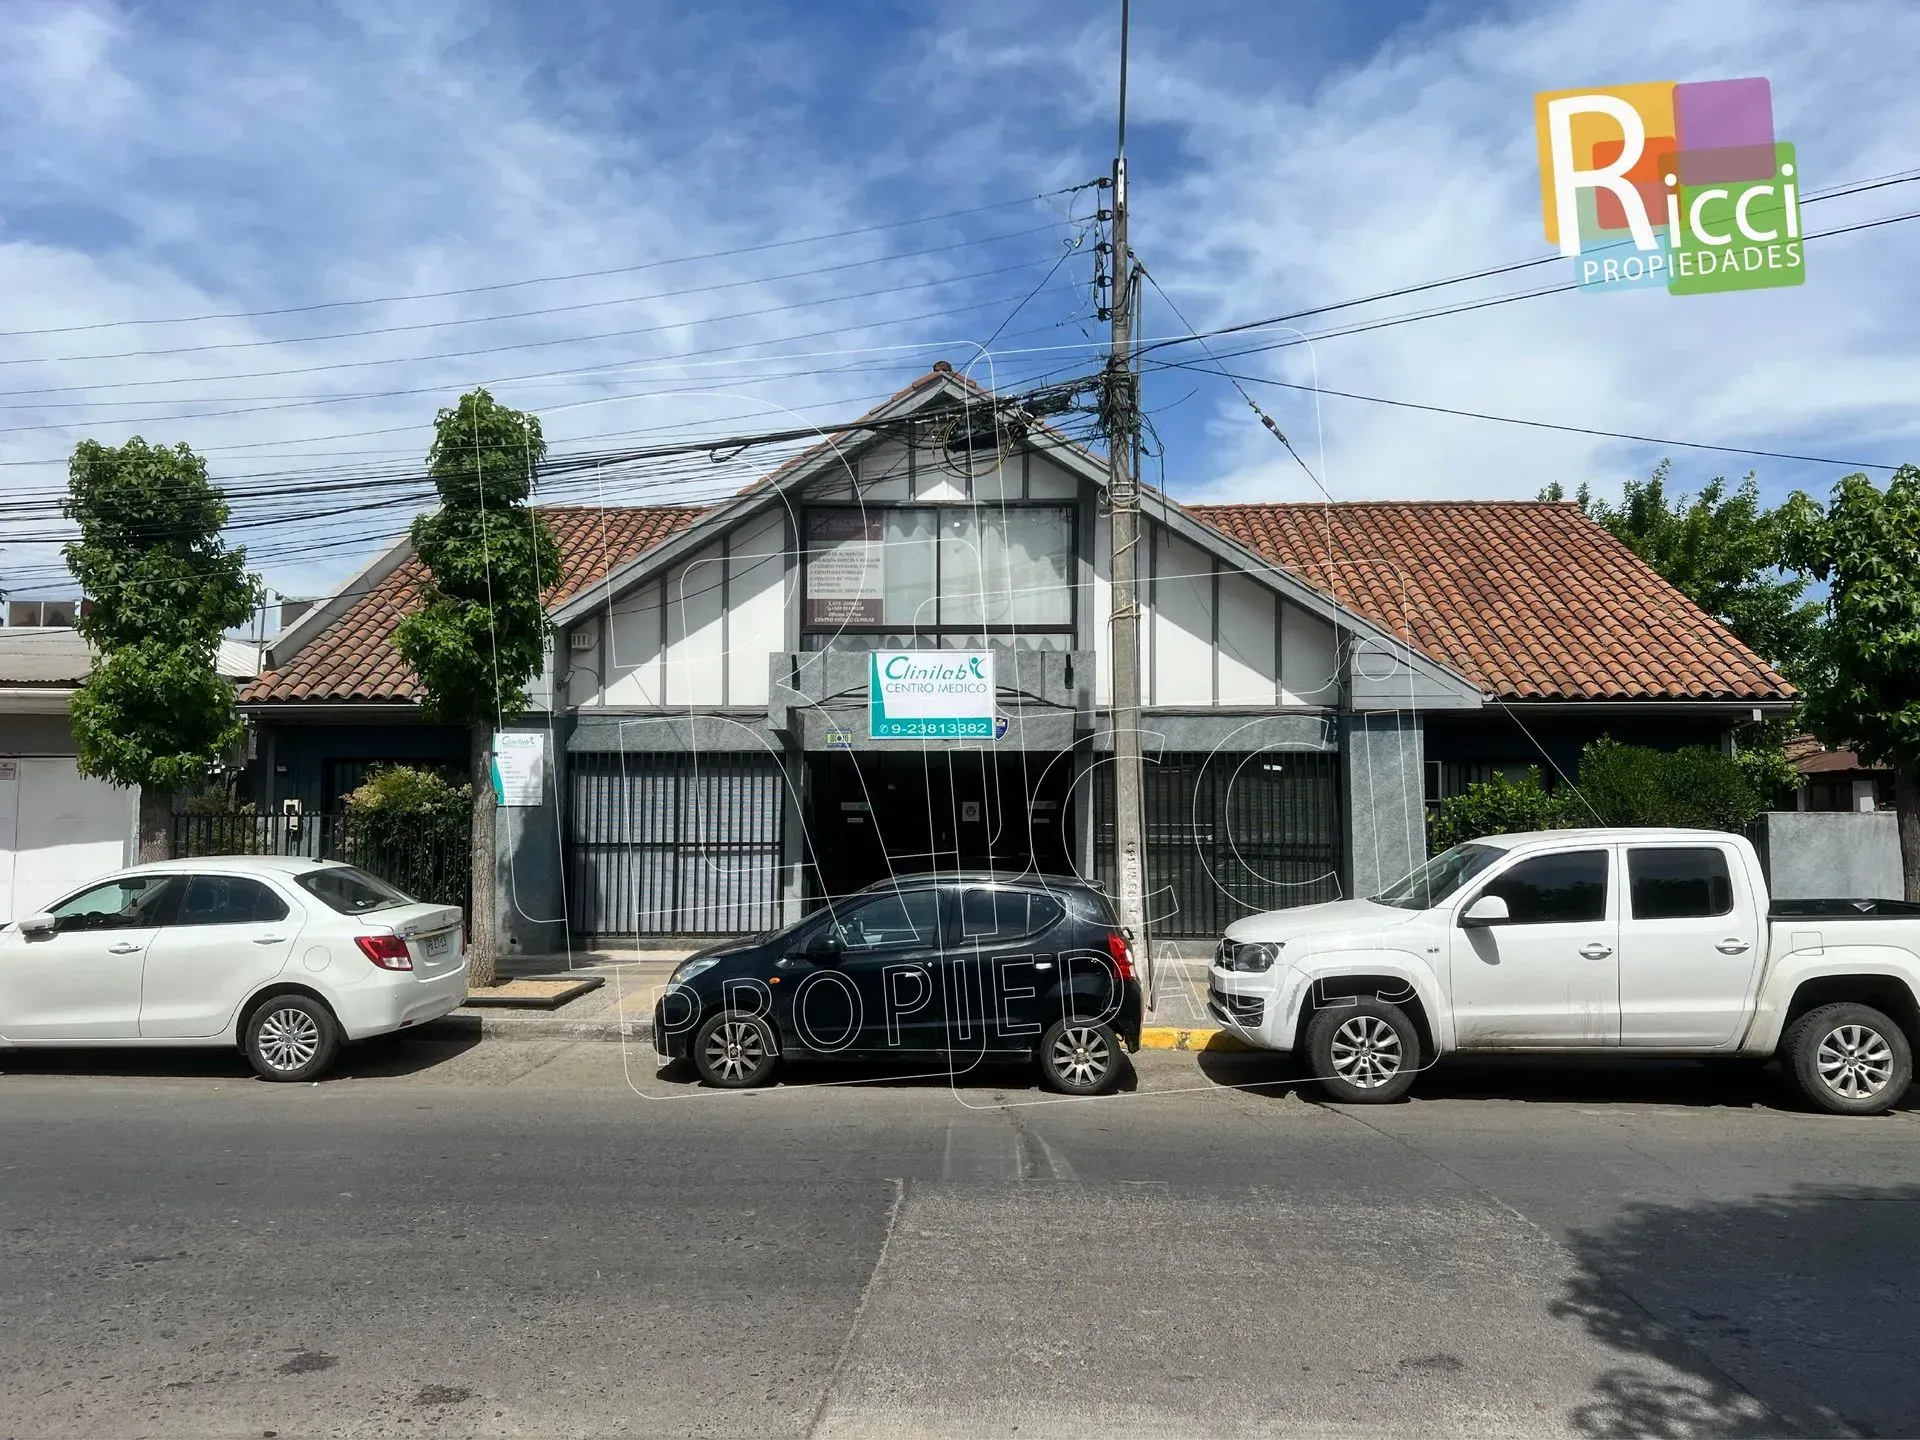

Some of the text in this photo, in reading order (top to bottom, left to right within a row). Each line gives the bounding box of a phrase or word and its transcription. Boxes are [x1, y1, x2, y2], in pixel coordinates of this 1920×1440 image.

[885, 656, 967, 680] Clinilab
[885, 683, 987, 693] CENTRO MEDICO
[891, 723, 987, 734] 9-23813382
